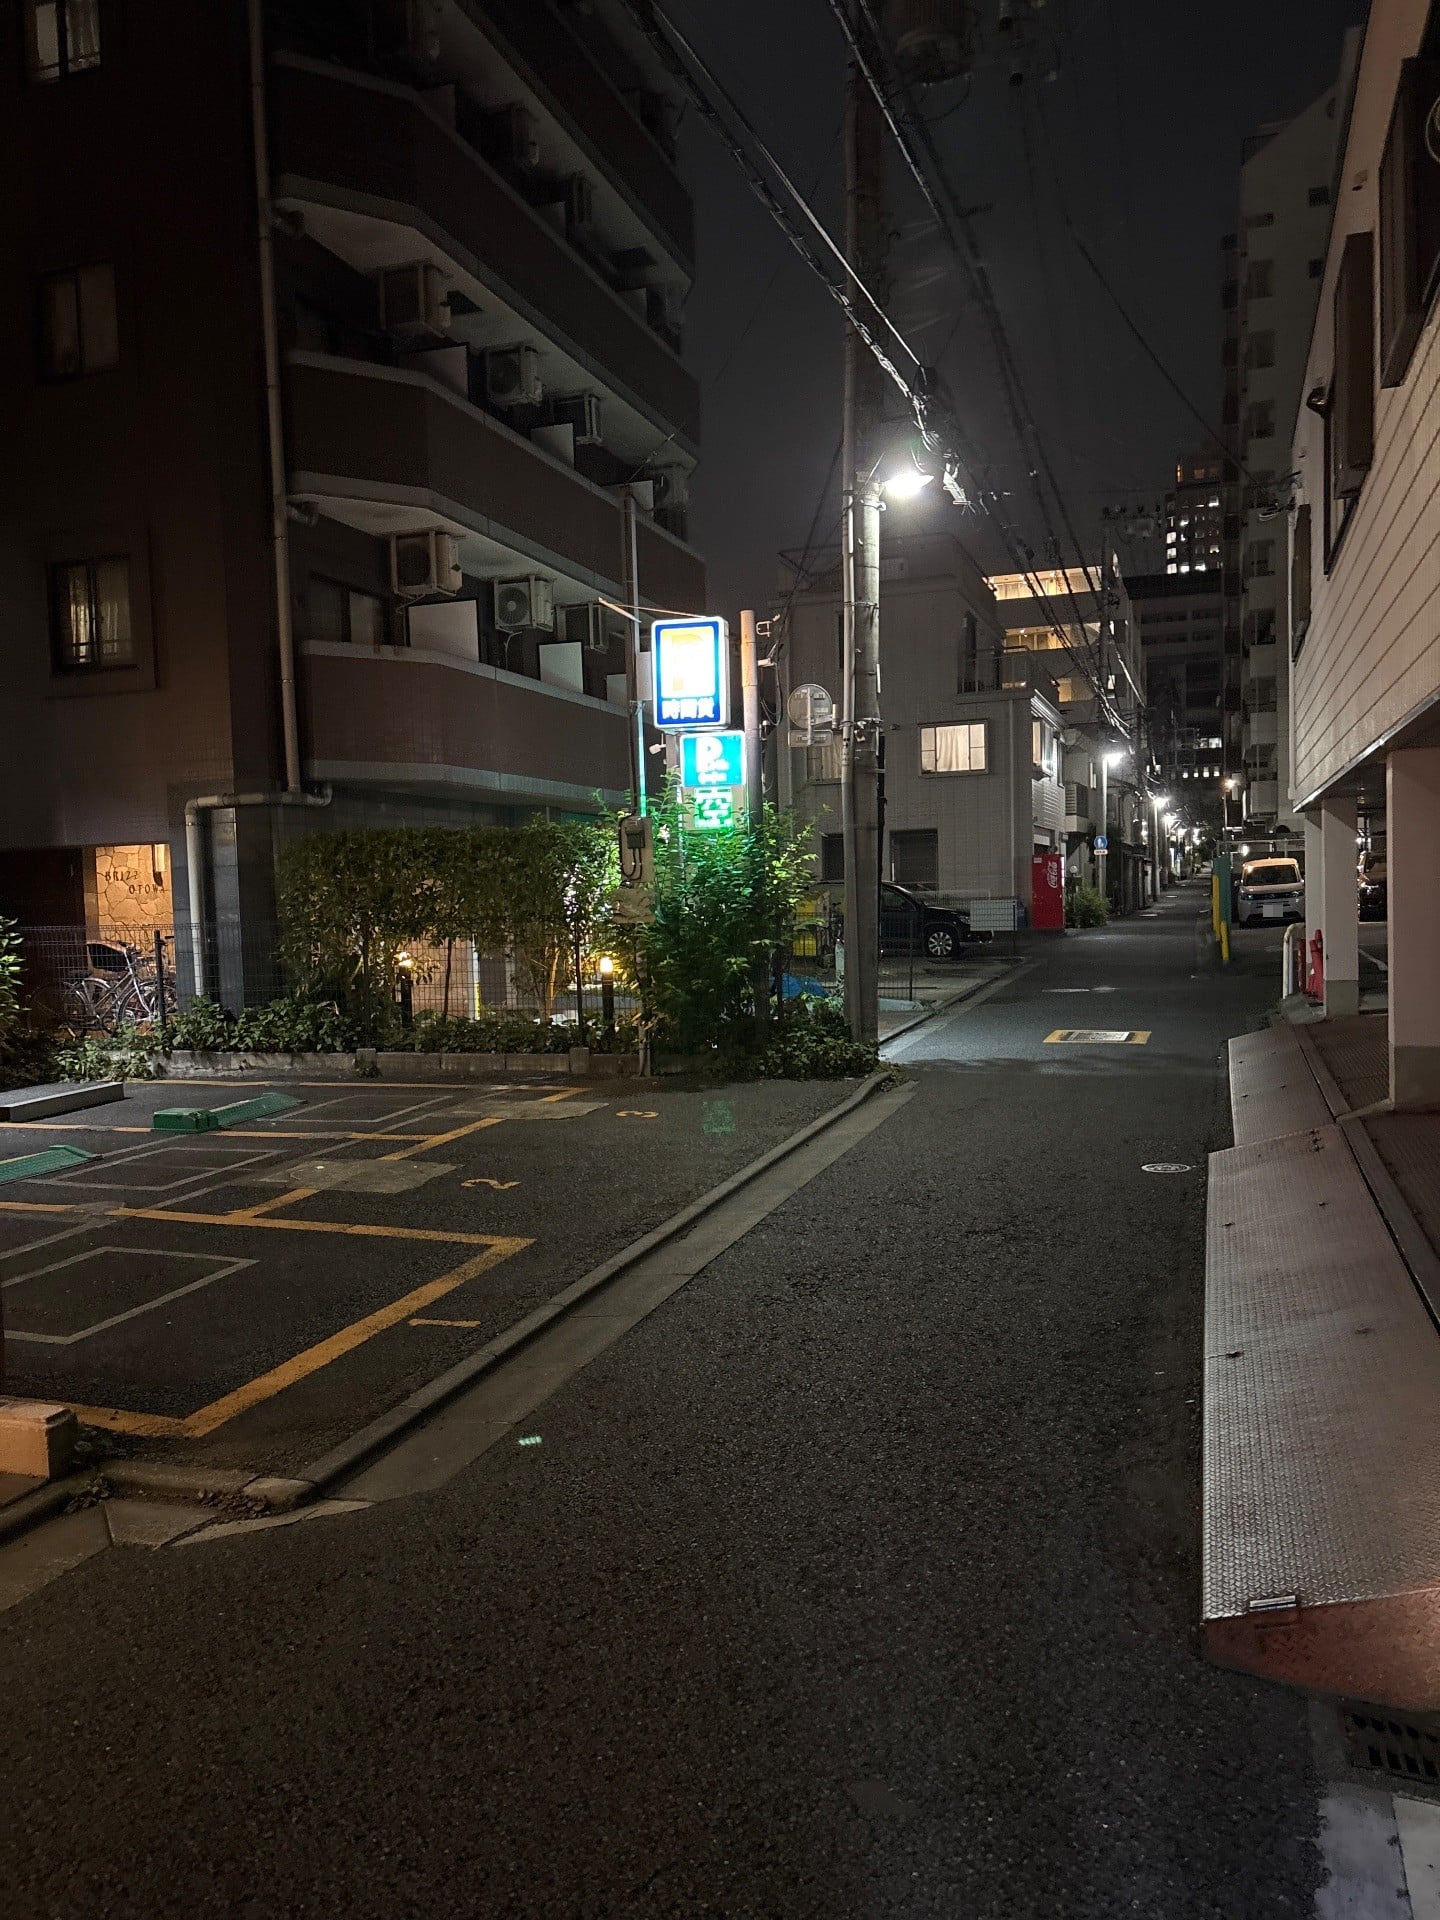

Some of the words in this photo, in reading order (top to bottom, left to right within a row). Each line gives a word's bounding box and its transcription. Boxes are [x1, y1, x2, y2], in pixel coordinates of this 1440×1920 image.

[694, 786, 733, 828] 空
[128, 884, 166, 895] OTOWA
[460, 1178, 522, 1190] 2
